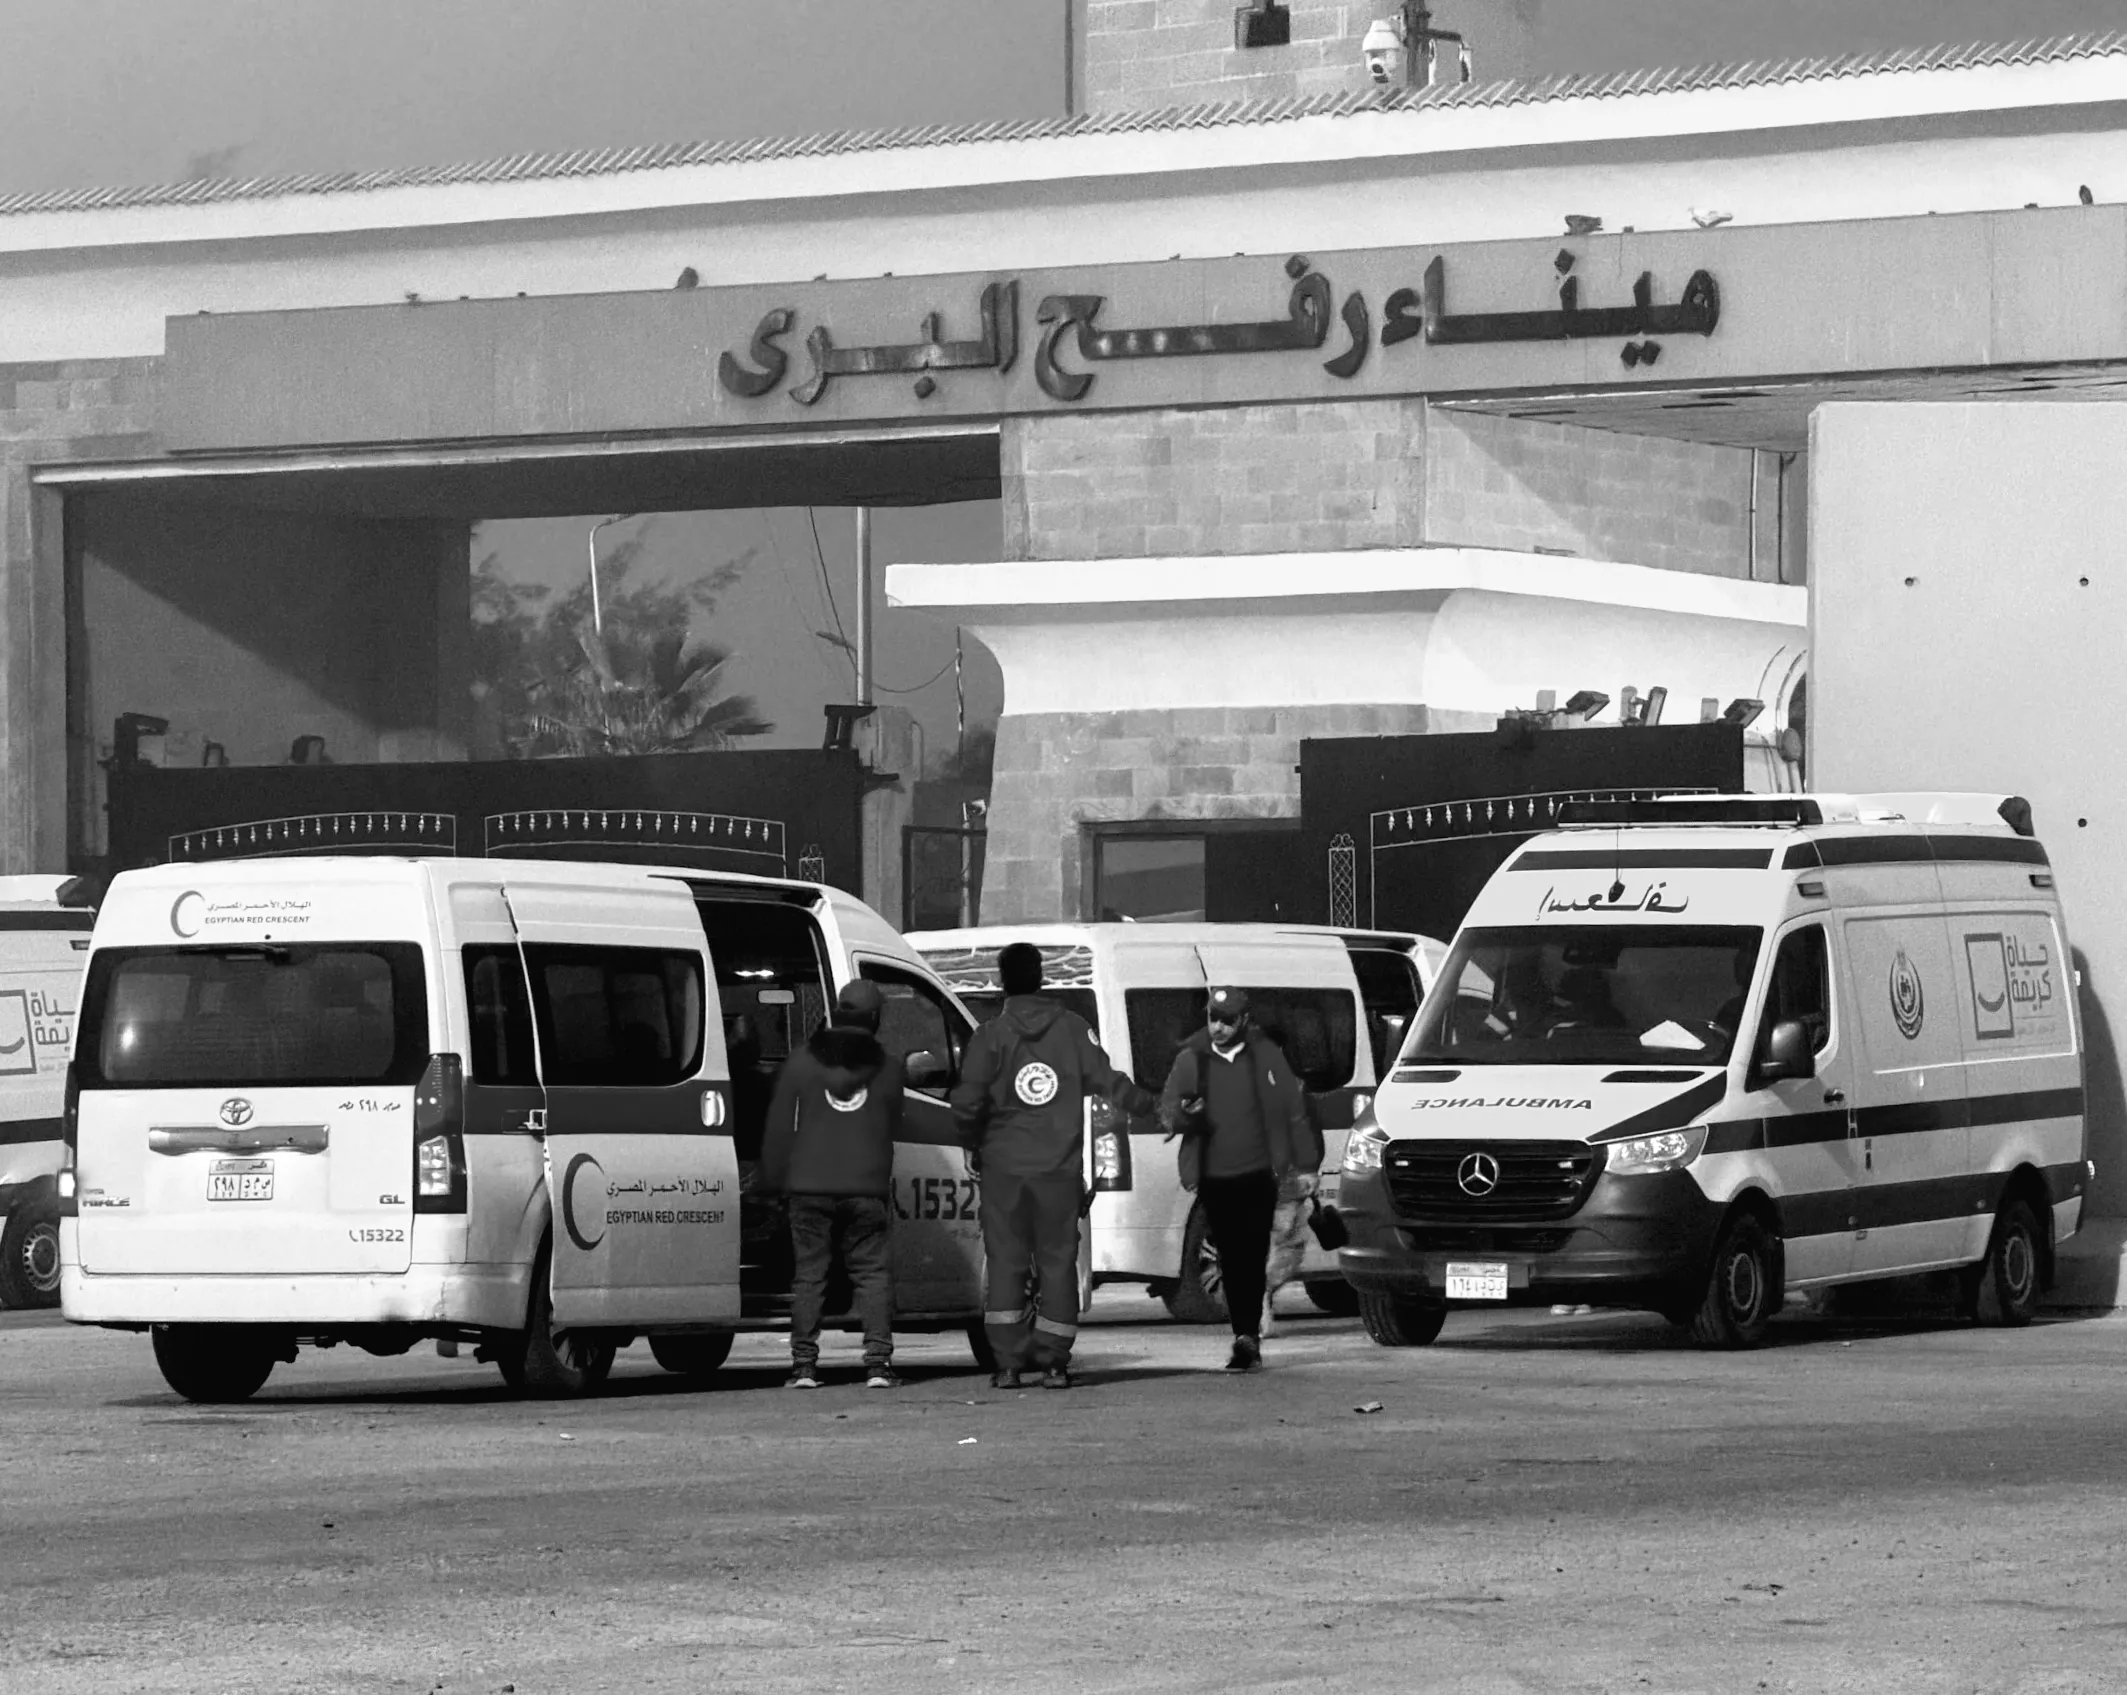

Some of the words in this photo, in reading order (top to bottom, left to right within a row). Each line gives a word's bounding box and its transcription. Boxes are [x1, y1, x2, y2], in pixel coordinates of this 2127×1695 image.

[1379, 248, 1721, 369] ميناء
[1034, 254, 1369, 401] رفح
[281, 899, 312, 910] الهلال
[205, 916, 245, 924] EGYPTIAN
[246, 916, 263, 924] RED
[265, 915, 311, 924] CRESCENT
[2006, 933, 2049, 976] حياة
[2011, 969, 2052, 1011] كريمة
[35, 1020, 71, 1052] يمة
[379, 1193, 405, 1205] GL
[692, 1179, 724, 1197] الهلال
[911, 1177, 977, 1220] 1532
[606, 1210, 653, 1224] EGYPTIAN
[655, 1210, 675, 1224] RED
[677, 1210, 725, 1224] CRESCENT
[359, 1229, 405, 1242] 15322
